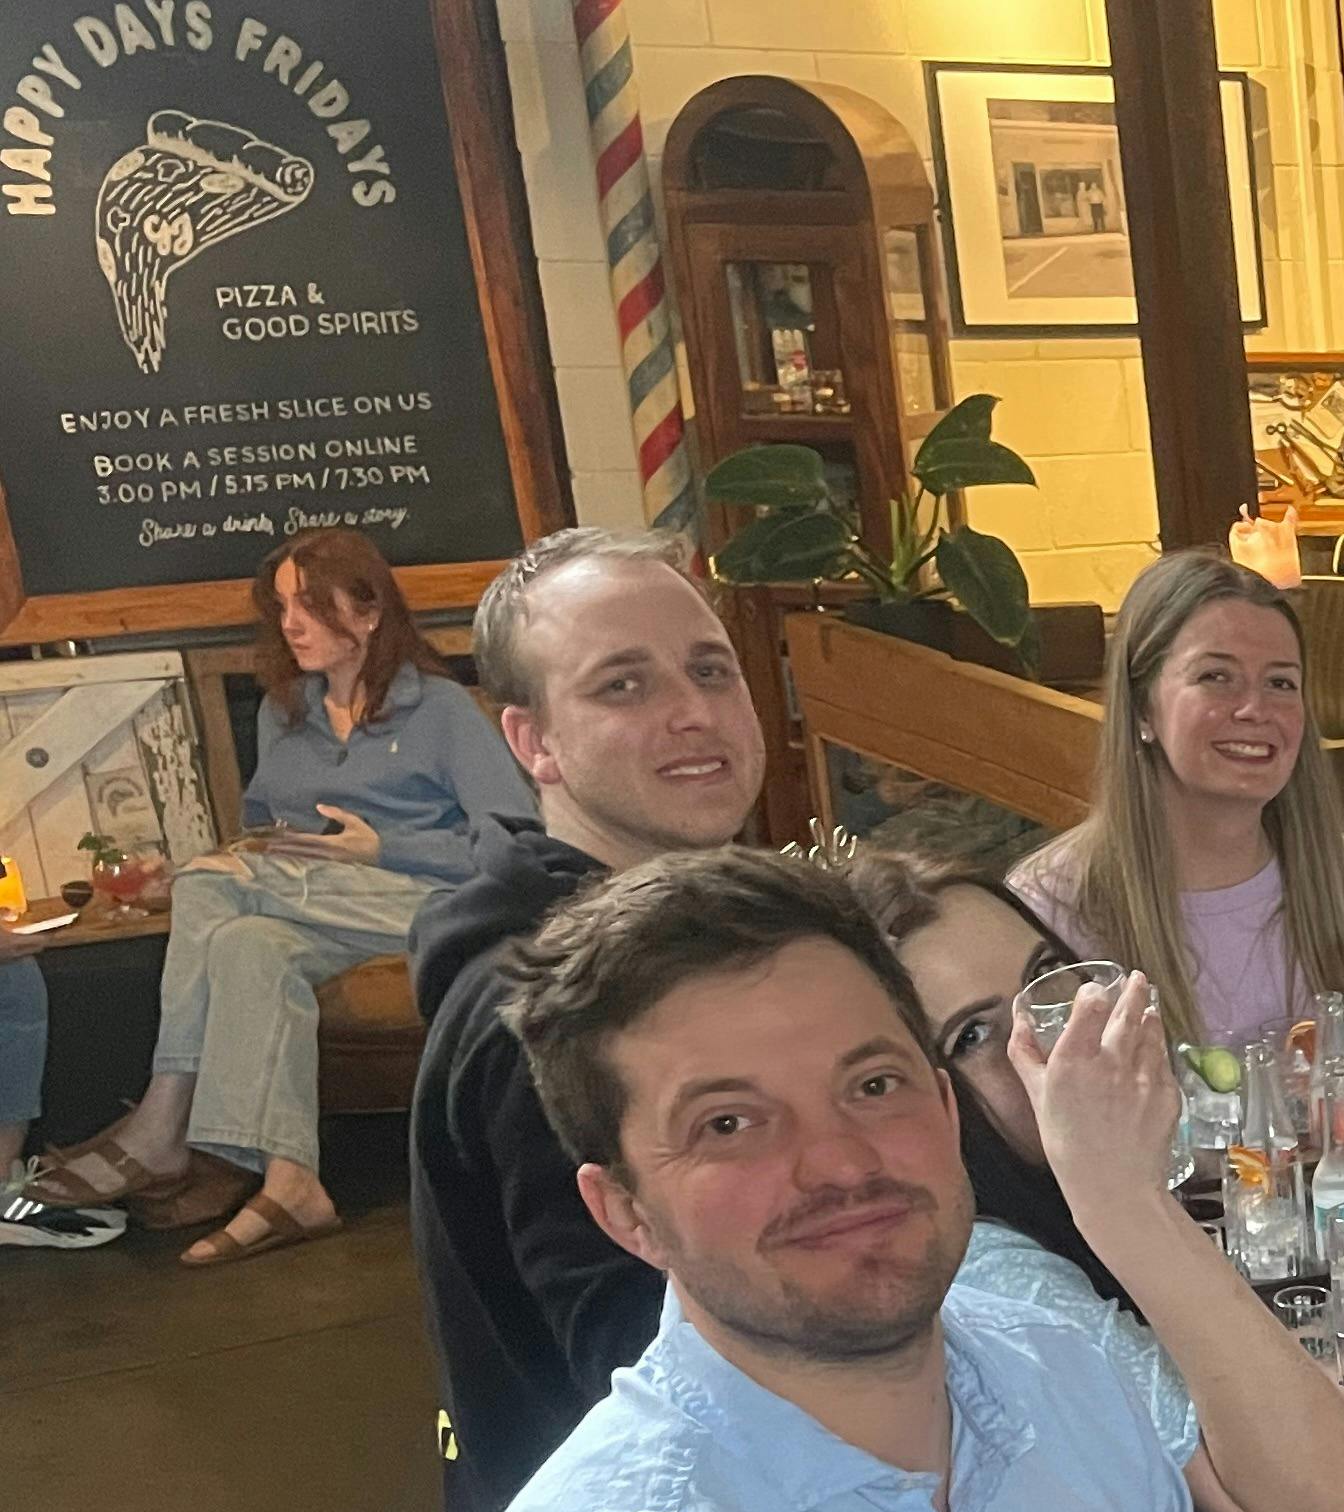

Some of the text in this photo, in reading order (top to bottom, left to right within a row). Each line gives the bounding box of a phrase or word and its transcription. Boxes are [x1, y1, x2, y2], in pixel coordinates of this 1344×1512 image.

[0, 0, 397, 216] HAPPY DAYS FRIDAYS
[216, 282, 325, 309] PIZZA &
[222, 309, 419, 341] GOOD SPIRITS
[60, 391, 432, 433] ENJOY A FRESH SLICE ON US
[94, 435, 417, 477] BOOK A SESSION ONLINE
[97, 483, 154, 505] 3.00
[162, 480, 201, 502] PM
[276, 471, 315, 490] PM
[390, 465, 430, 485] PM
[139, 518, 197, 547] Share
[202, 522, 217, 536] a
[284, 506, 340, 535] Share
